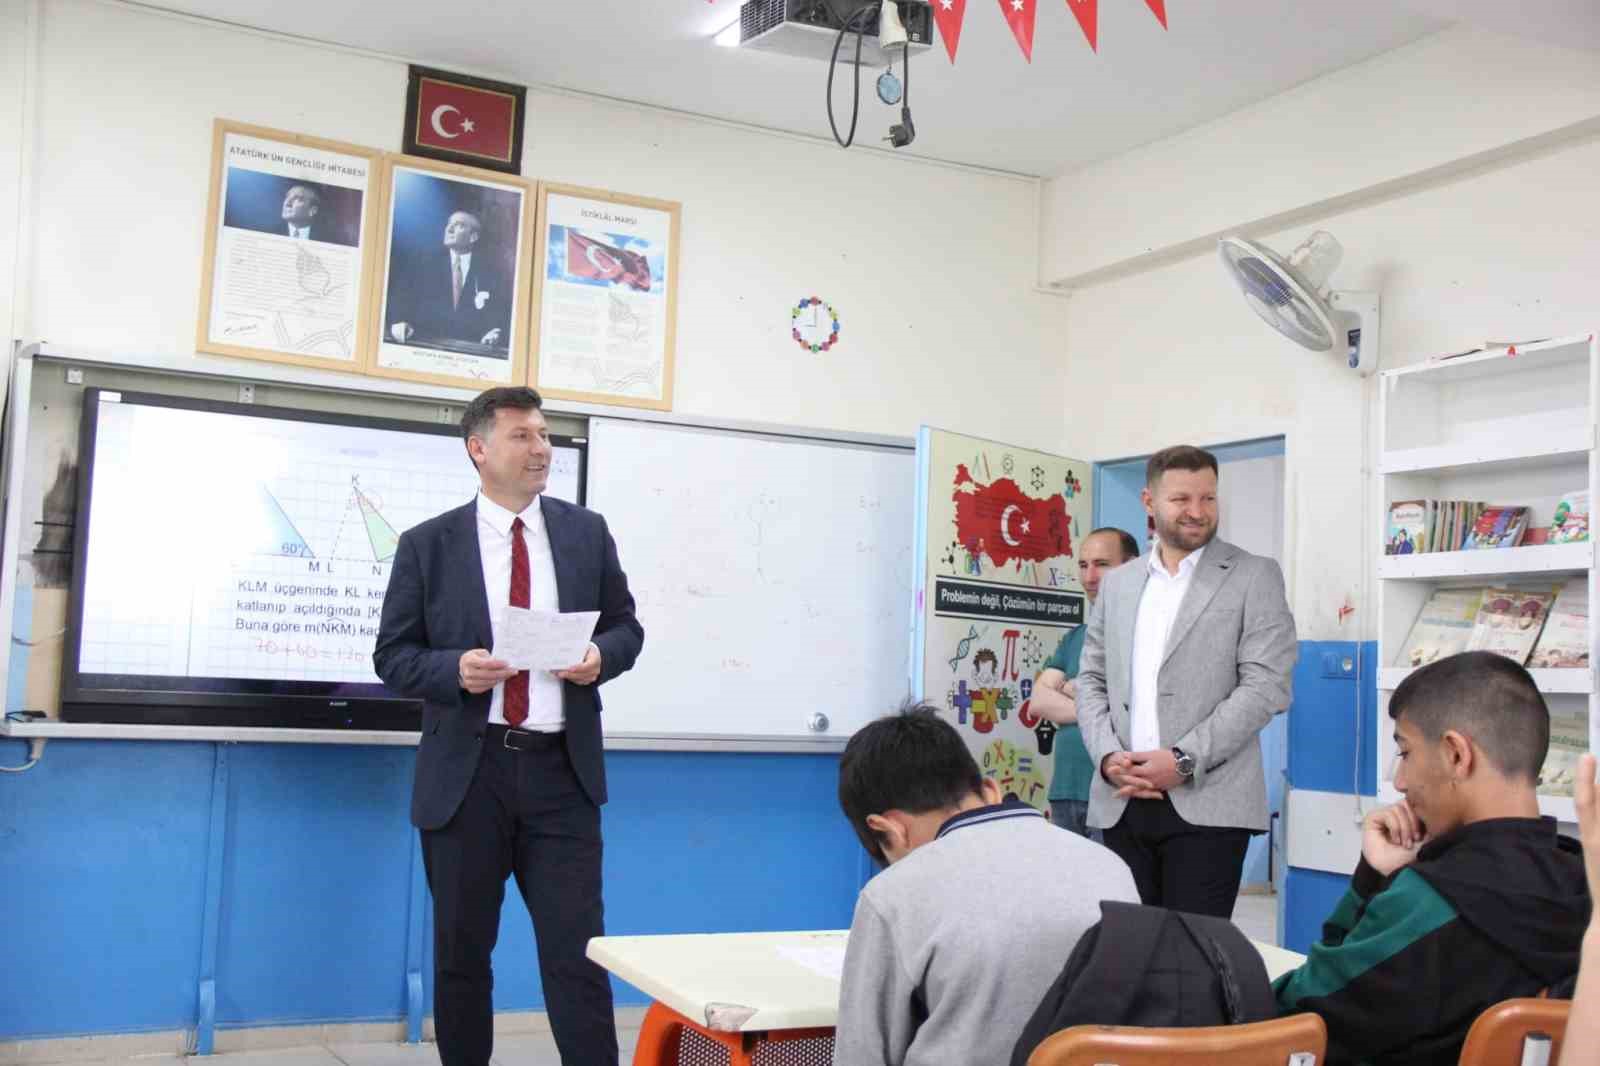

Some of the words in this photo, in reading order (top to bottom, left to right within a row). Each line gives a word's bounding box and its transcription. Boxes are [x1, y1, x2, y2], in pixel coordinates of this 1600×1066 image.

[308, 561, 320, 572] M
[372, 565, 382, 576] N
[238, 579, 267, 592] KLM
[345, 585, 360, 598] KL
[941, 588, 980, 604] Problemin
[235, 617, 269, 631] Buna
